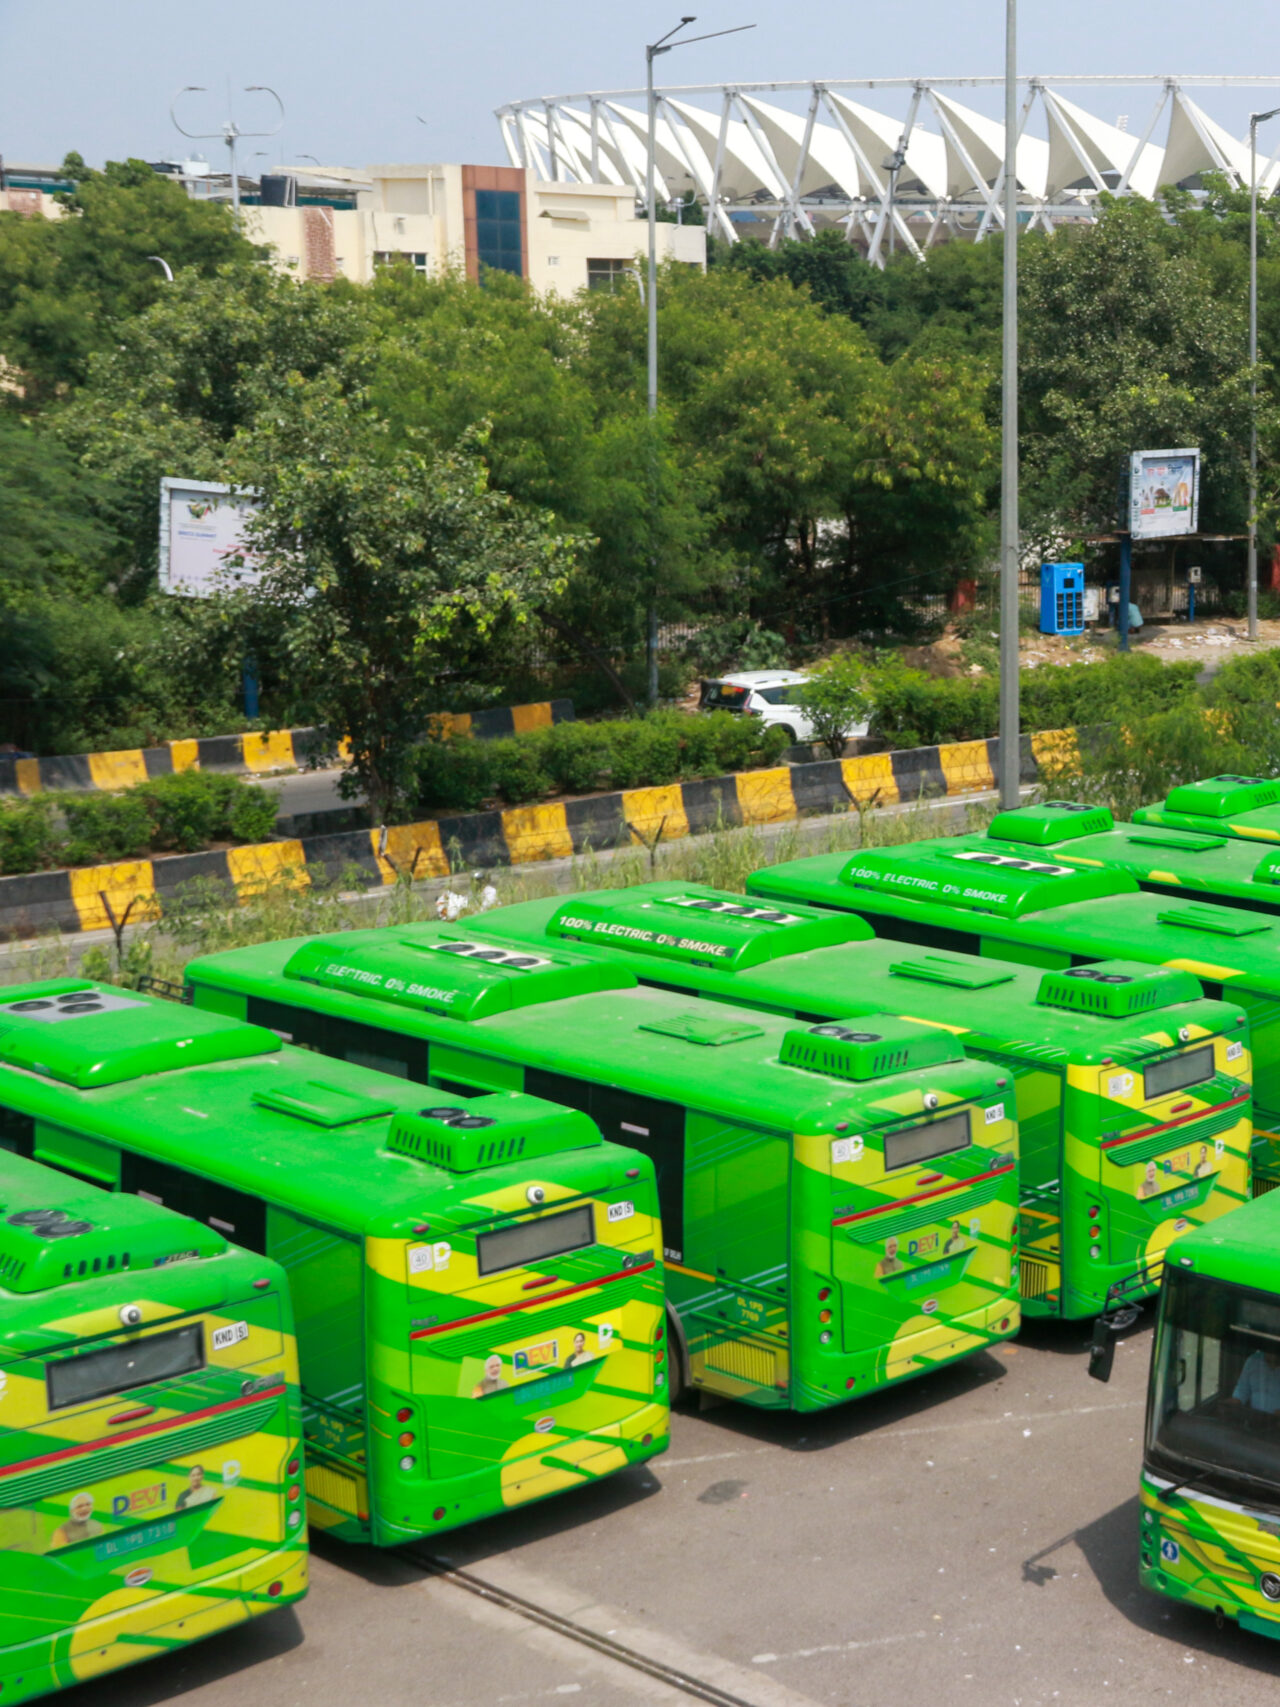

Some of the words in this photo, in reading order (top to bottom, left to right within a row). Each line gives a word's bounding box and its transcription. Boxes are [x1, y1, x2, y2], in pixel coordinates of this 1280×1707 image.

[850, 867, 881, 880] 100%
[882, 873, 939, 891] ELECTRIC.
[942, 884, 961, 894] 0%
[962, 887, 1008, 903] SMOKE.
[559, 916, 593, 930] 100%
[594, 922, 653, 942] ELECTRIC.
[656, 934, 676, 946] 0%
[678, 938, 727, 956] SMOKE.
[325, 963, 382, 985] ELECTRIC.
[384, 978, 406, 991] 0%
[406, 983, 455, 1003] SMOKE.
[215, 1328, 233, 1345] KND
